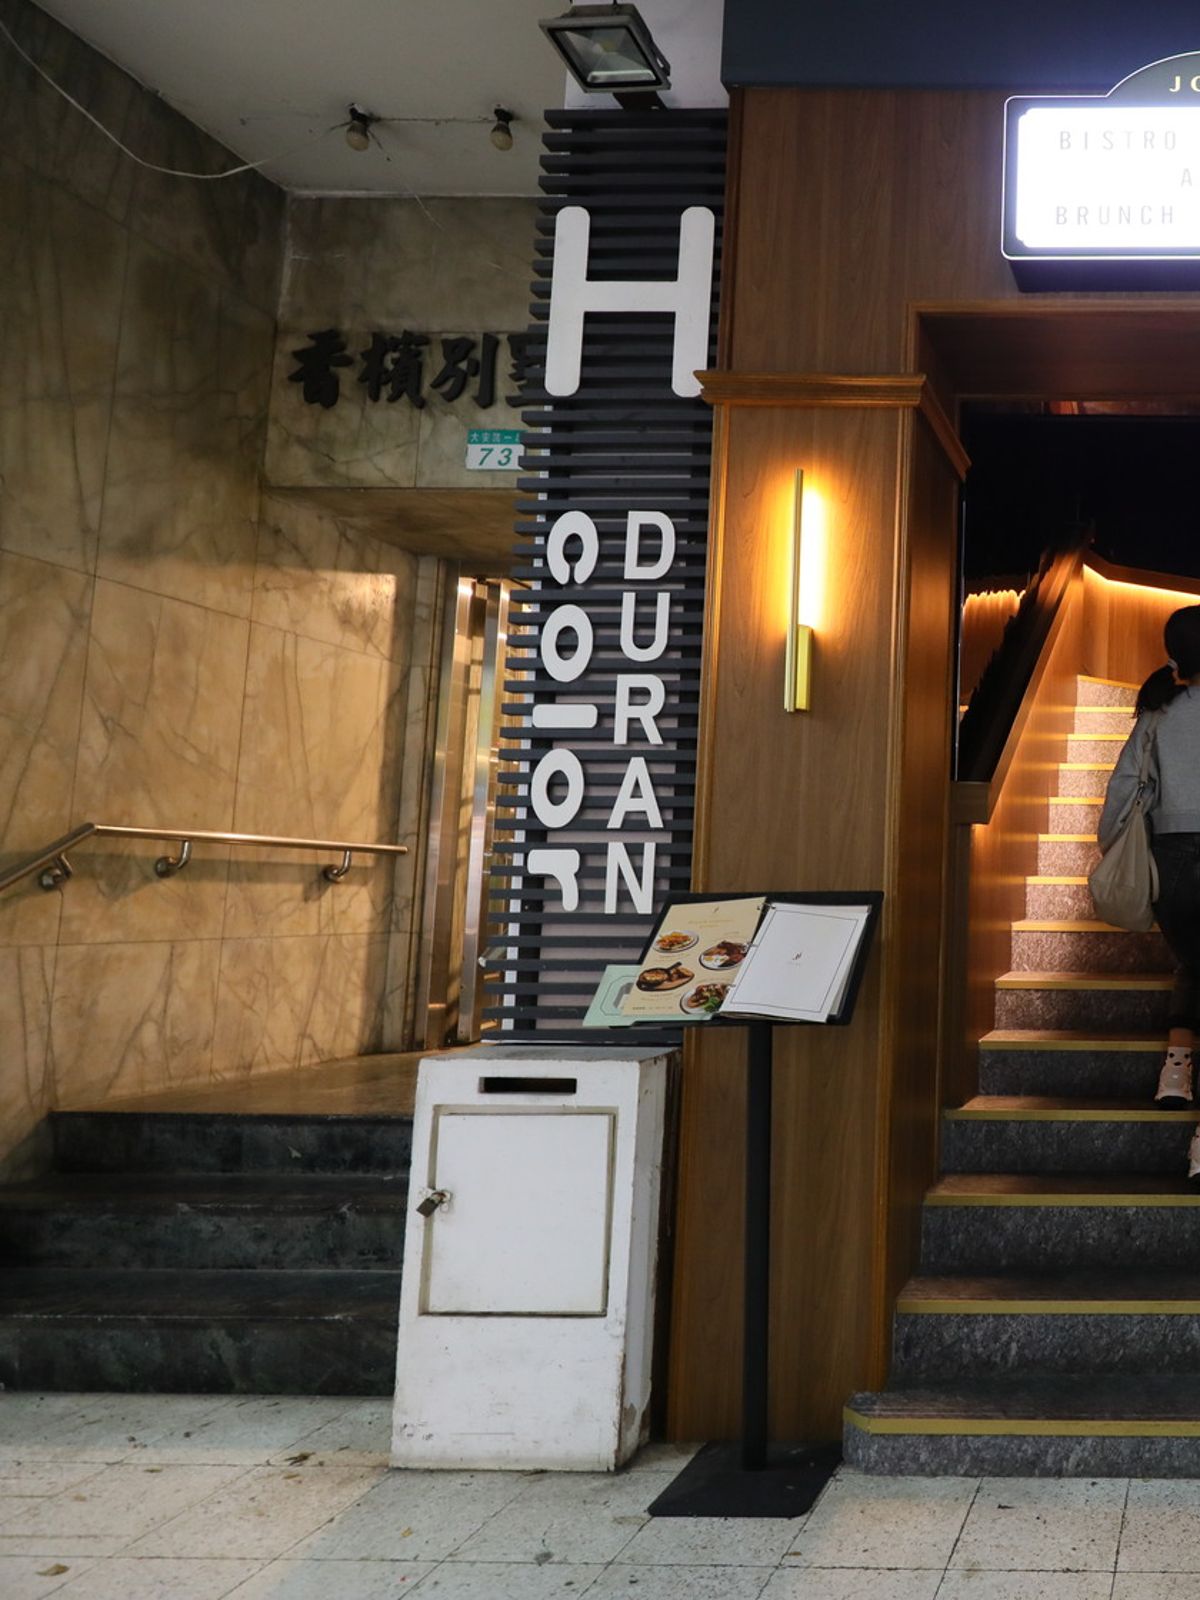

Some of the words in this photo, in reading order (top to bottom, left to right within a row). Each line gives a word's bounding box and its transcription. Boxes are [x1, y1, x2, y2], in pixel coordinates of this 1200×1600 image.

[1059, 130, 1177, 150] BISTRO
[1055, 206, 1175, 226] BRUNCH
[544, 206, 715, 397] H
[470, 432, 520, 443] 大安路一
[478, 448, 512, 466] 73
[604, 510, 676, 915] DURAN
